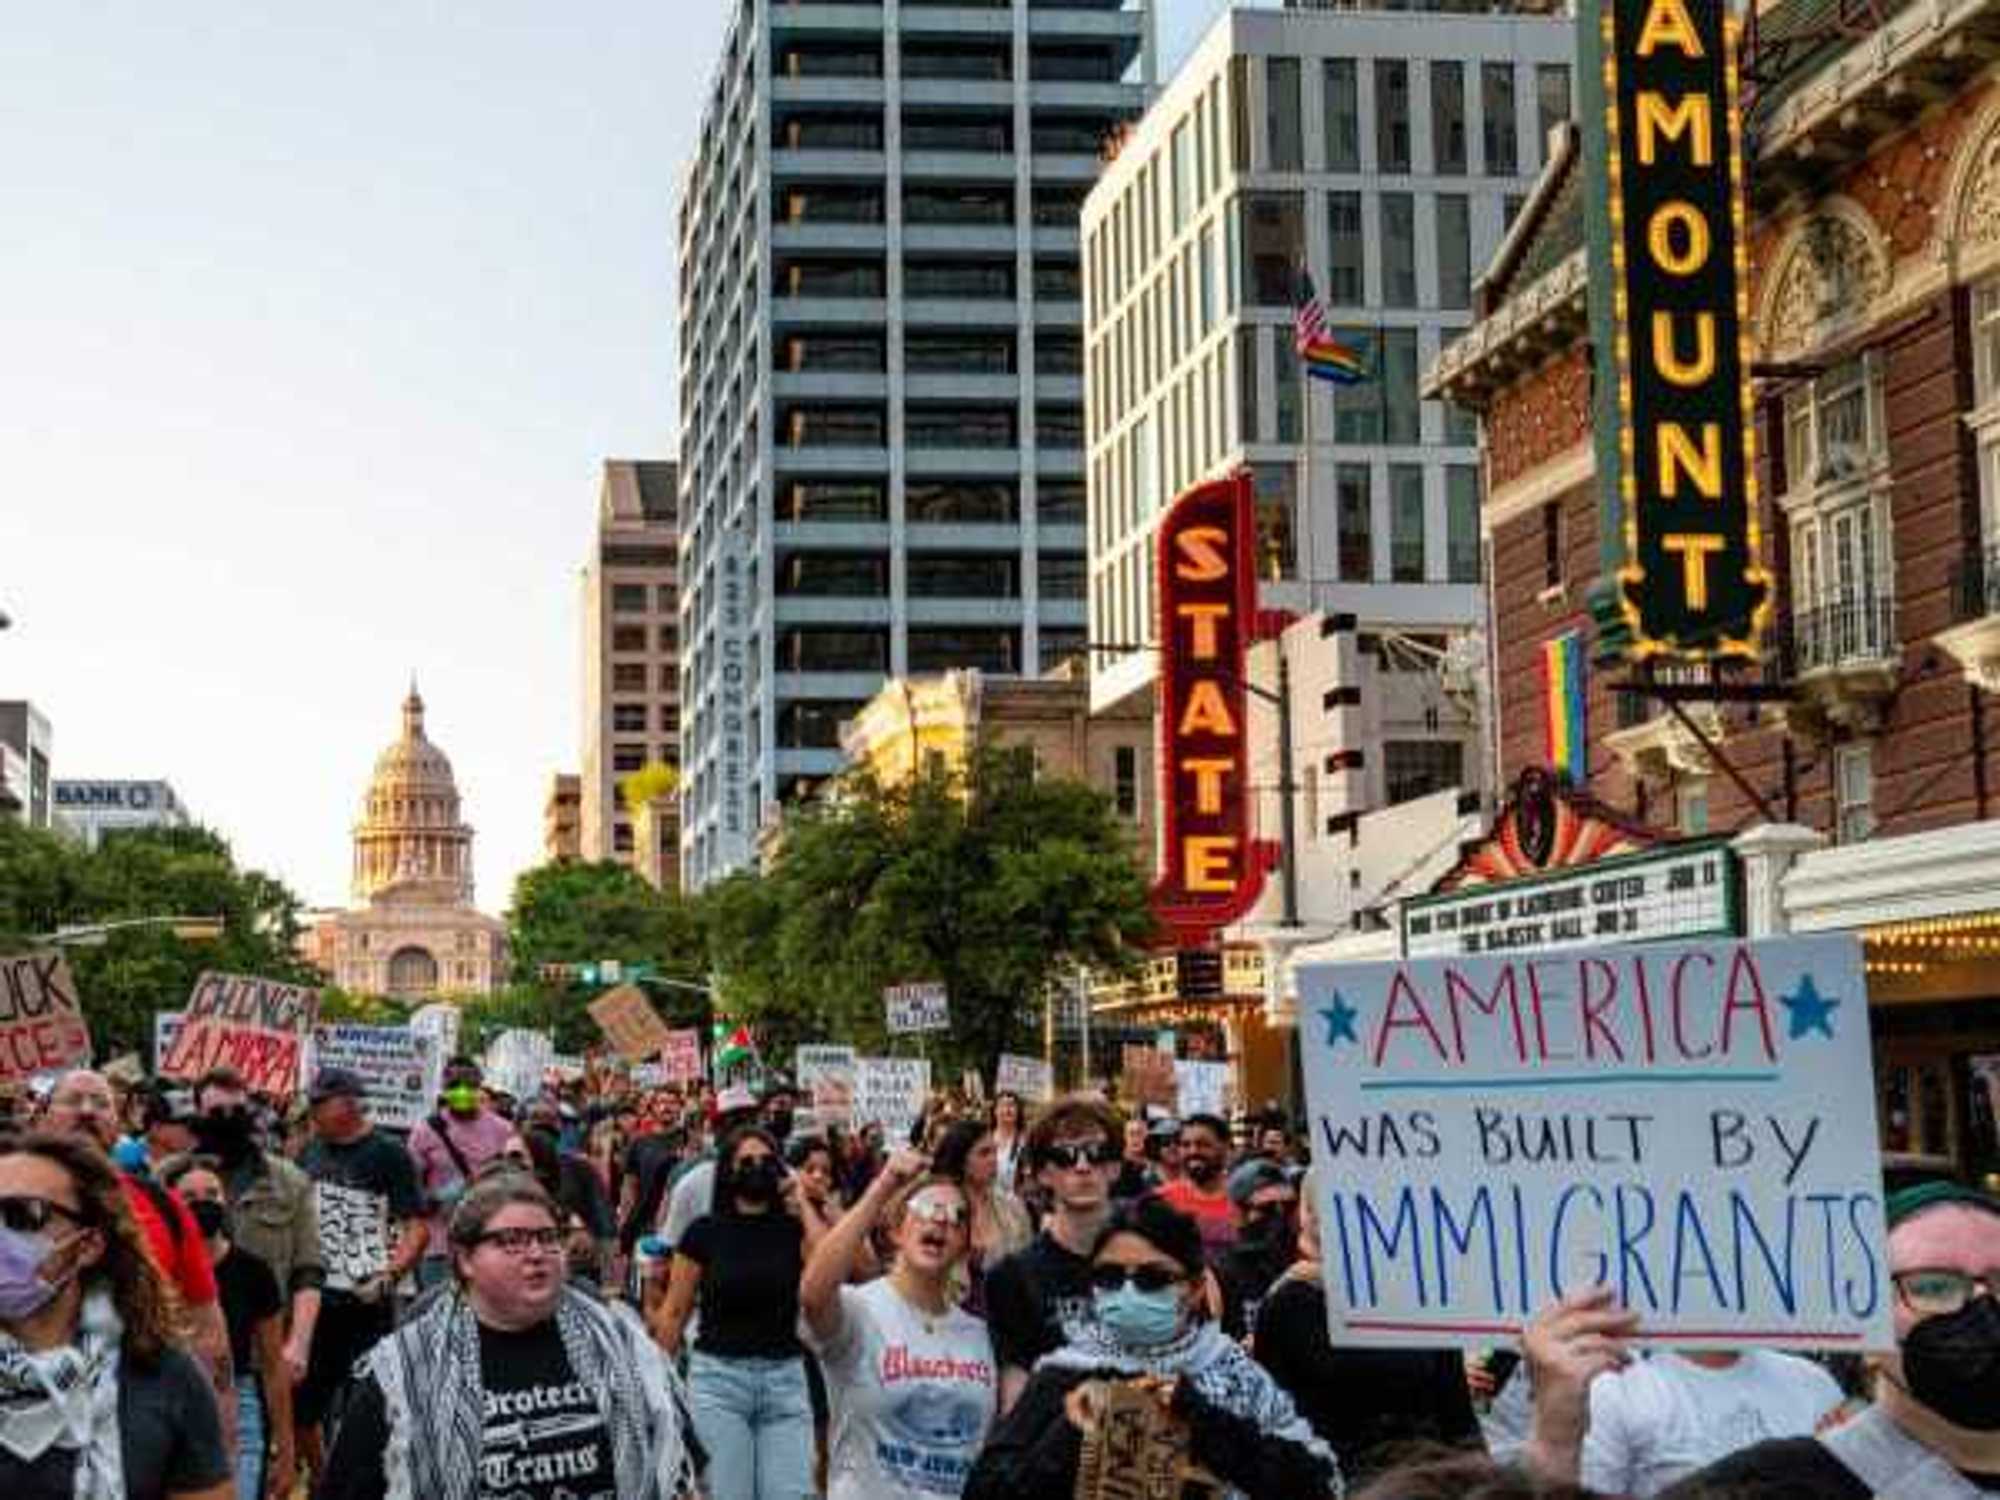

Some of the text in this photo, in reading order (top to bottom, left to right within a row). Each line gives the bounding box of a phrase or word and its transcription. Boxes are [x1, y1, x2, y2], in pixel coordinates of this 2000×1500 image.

[1174, 527, 1237, 894] STATE
[56, 786, 122, 804] BANK
[1373, 945, 1778, 1066] AMERICA
[1321, 1105, 1821, 1185] WAS BUILT BY
[1333, 1182, 1879, 1319] IMMIGRANTS
[478, 1444, 598, 1488] Trans
